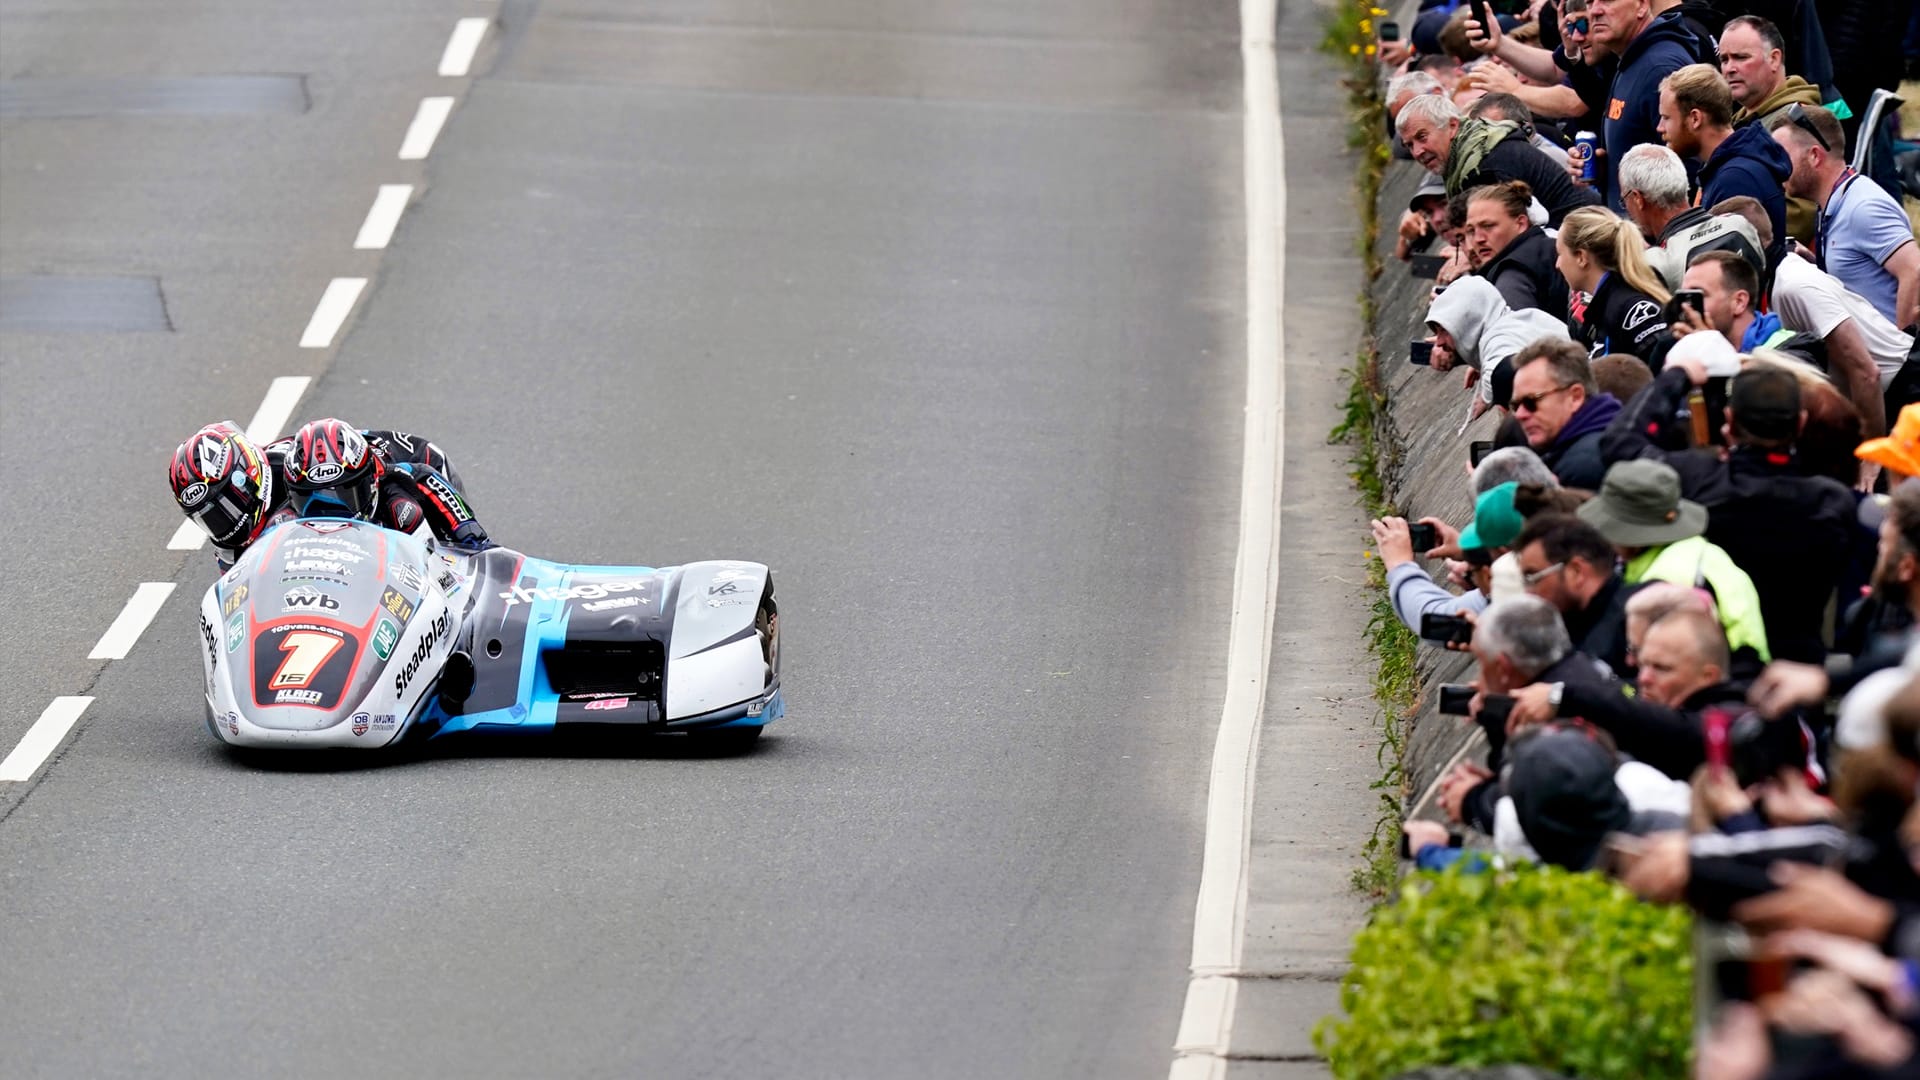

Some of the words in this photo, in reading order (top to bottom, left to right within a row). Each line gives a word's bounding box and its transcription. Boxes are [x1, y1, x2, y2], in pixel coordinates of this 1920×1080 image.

[310, 467, 338, 479] Arai
[183, 485, 205, 503] Arai
[271, 624, 345, 637] 100vans.com
[273, 633, 341, 688] 1
